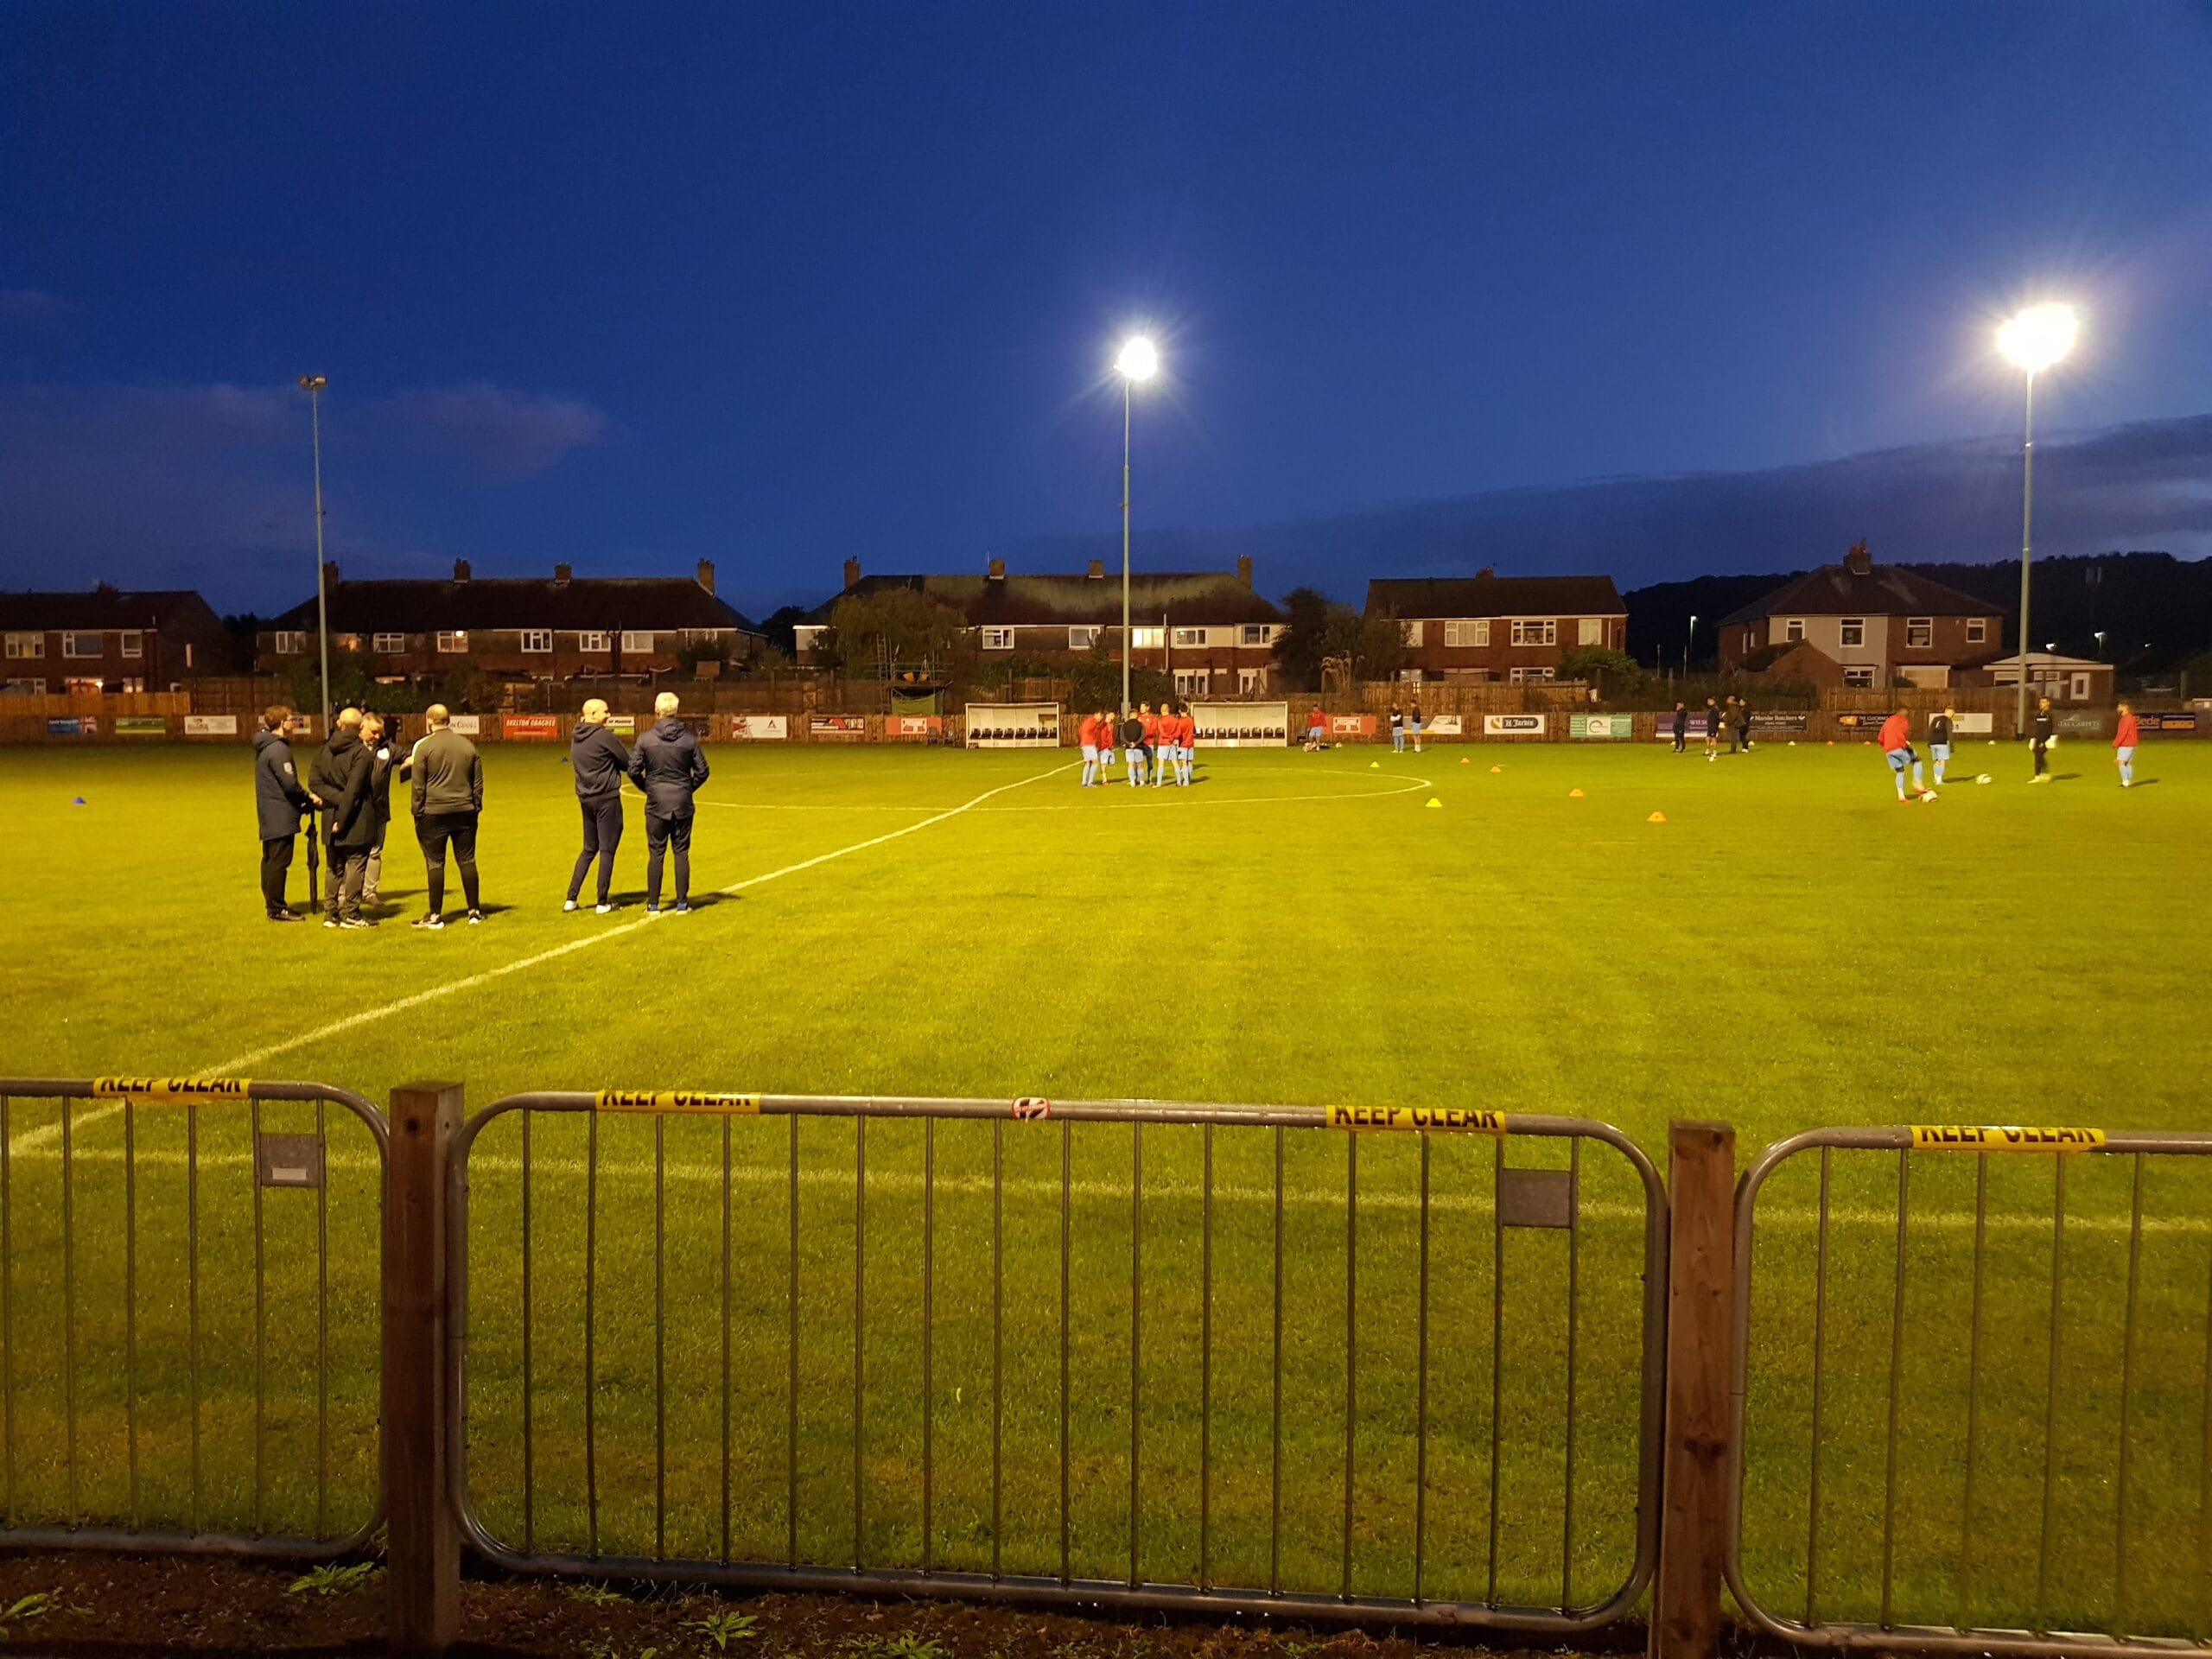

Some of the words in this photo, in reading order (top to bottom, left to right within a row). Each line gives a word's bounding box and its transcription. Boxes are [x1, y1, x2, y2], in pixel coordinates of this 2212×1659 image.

[1513, 719, 1535, 728] Jarvis
[1335, 1106, 1401, 1125] KEEP
[1411, 1108, 1498, 1128] CLEAR
